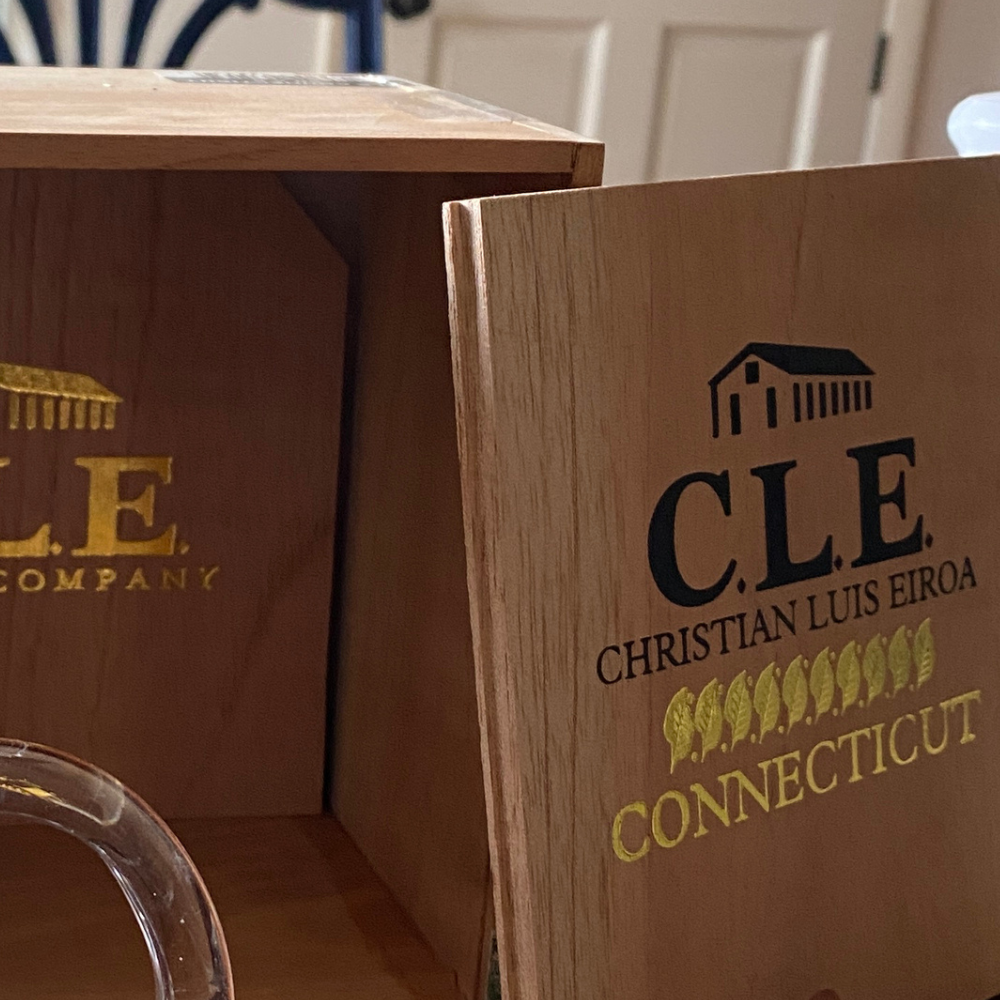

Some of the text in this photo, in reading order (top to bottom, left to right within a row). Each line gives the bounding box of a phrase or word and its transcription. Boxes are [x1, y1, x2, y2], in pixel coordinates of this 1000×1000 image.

[647, 437, 934, 608] C.L.E.
[596, 556, 977, 686] CHRISTIAN LUIS EIROA
[611, 690, 982, 863] CONNECTICUT
